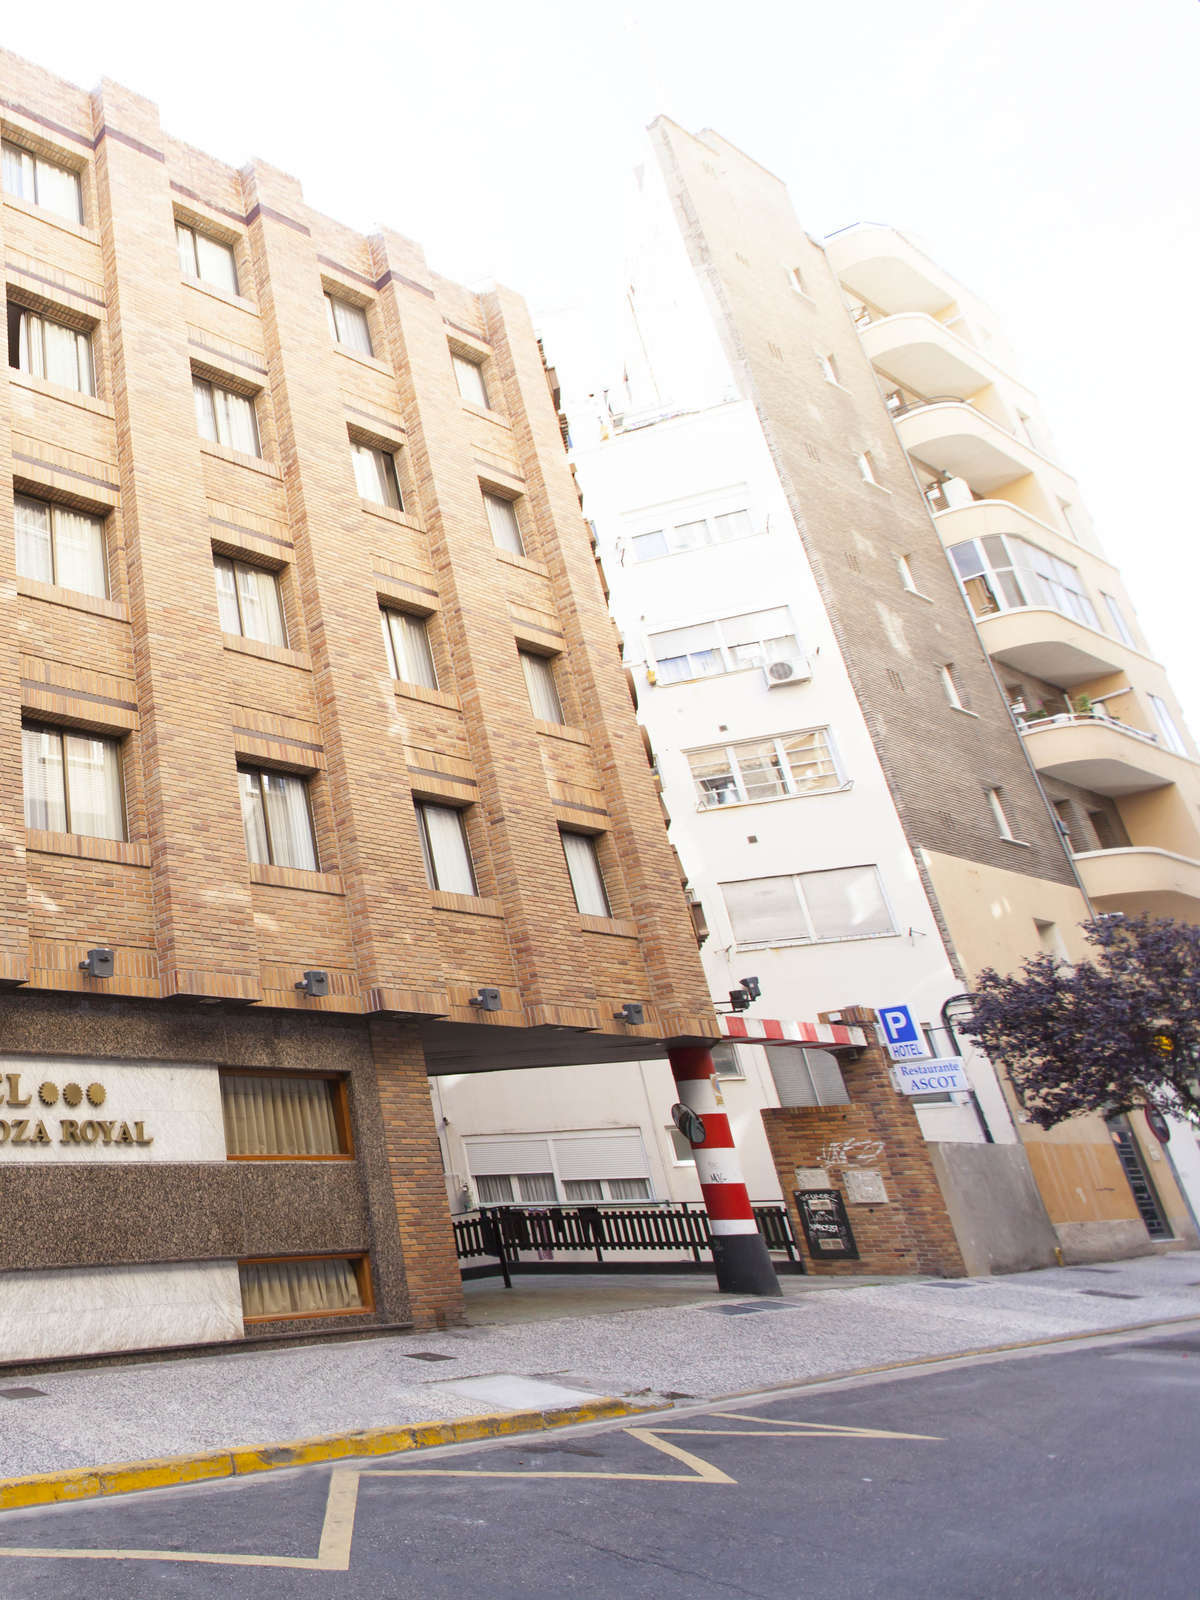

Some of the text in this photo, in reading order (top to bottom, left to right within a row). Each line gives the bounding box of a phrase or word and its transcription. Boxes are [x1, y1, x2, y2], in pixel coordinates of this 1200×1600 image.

[884, 1011, 907, 1040] P
[892, 1043, 923, 1057] HOTEL
[901, 1063, 960, 1076] Restaurante
[911, 1075, 958, 1091] ASCOT
[60, 1118, 154, 1145] ROYAL
